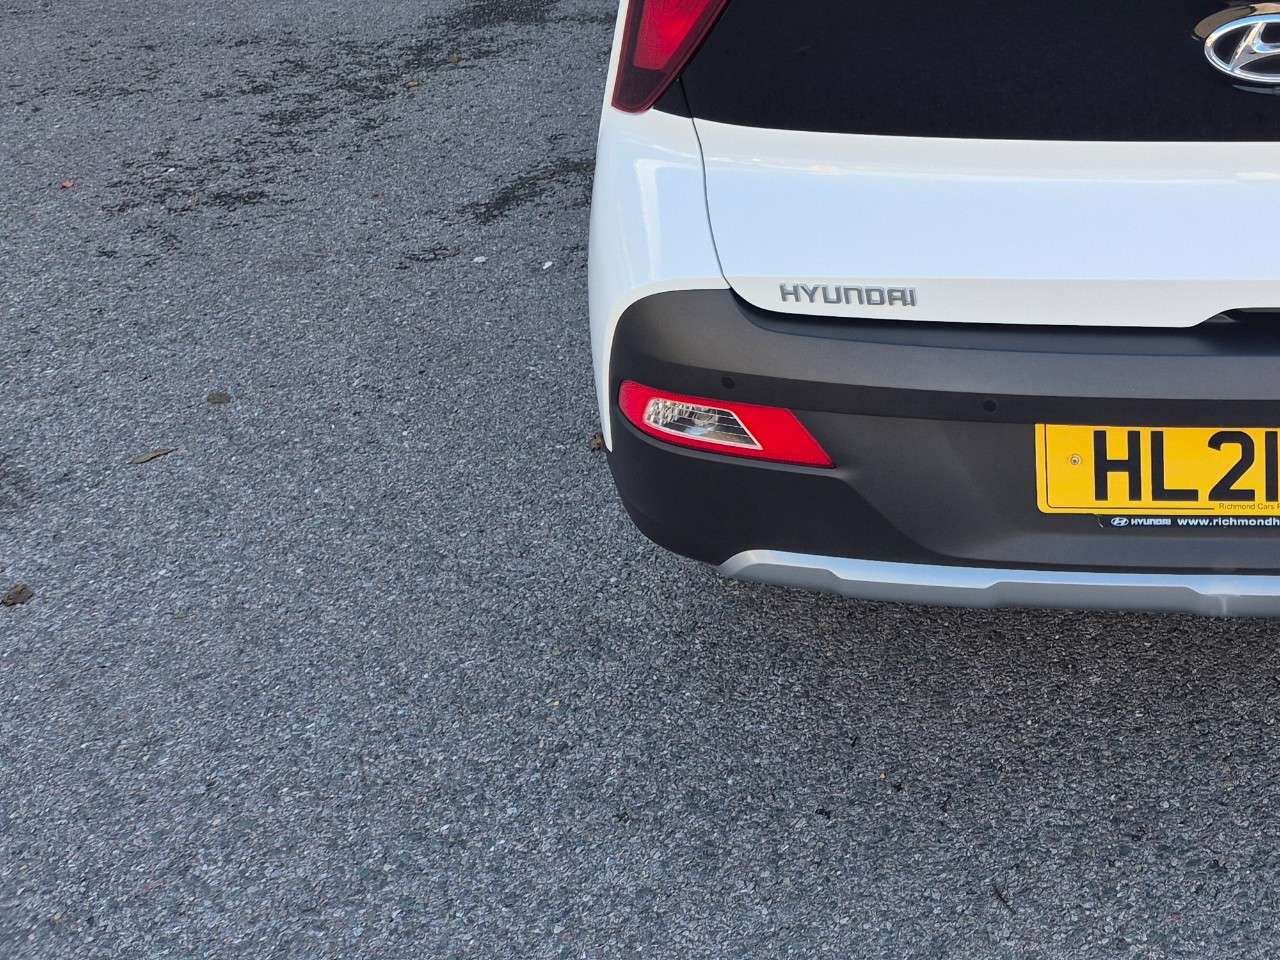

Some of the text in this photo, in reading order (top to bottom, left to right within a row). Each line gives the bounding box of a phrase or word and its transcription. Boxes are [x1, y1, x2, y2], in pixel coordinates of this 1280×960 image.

[779, 283, 917, 307] HYUNDAI
[1092, 430, 1278, 503] HL21
[1219, 503, 1255, 511] Richmond
